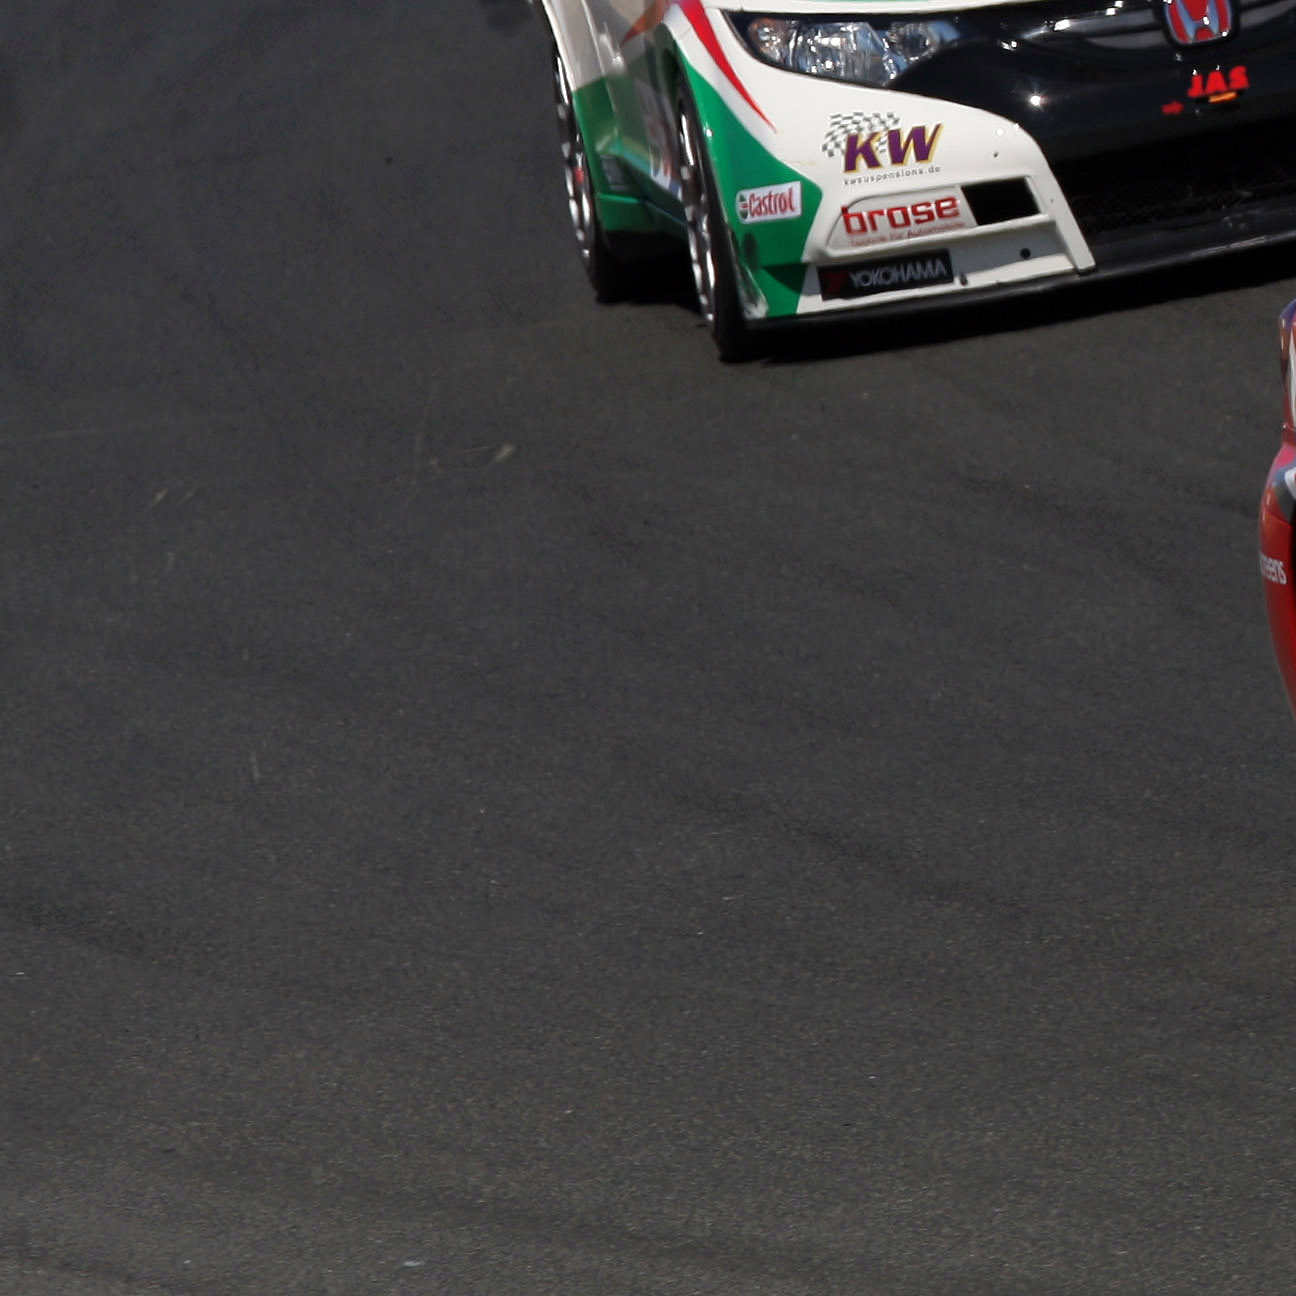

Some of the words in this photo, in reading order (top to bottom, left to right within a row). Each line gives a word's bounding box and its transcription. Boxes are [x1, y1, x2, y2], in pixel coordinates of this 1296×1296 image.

[843, 122, 944, 174] KW
[749, 186, 798, 217] Castrol
[840, 195, 962, 237] brose
[849, 257, 949, 289] YOKOHAMA
